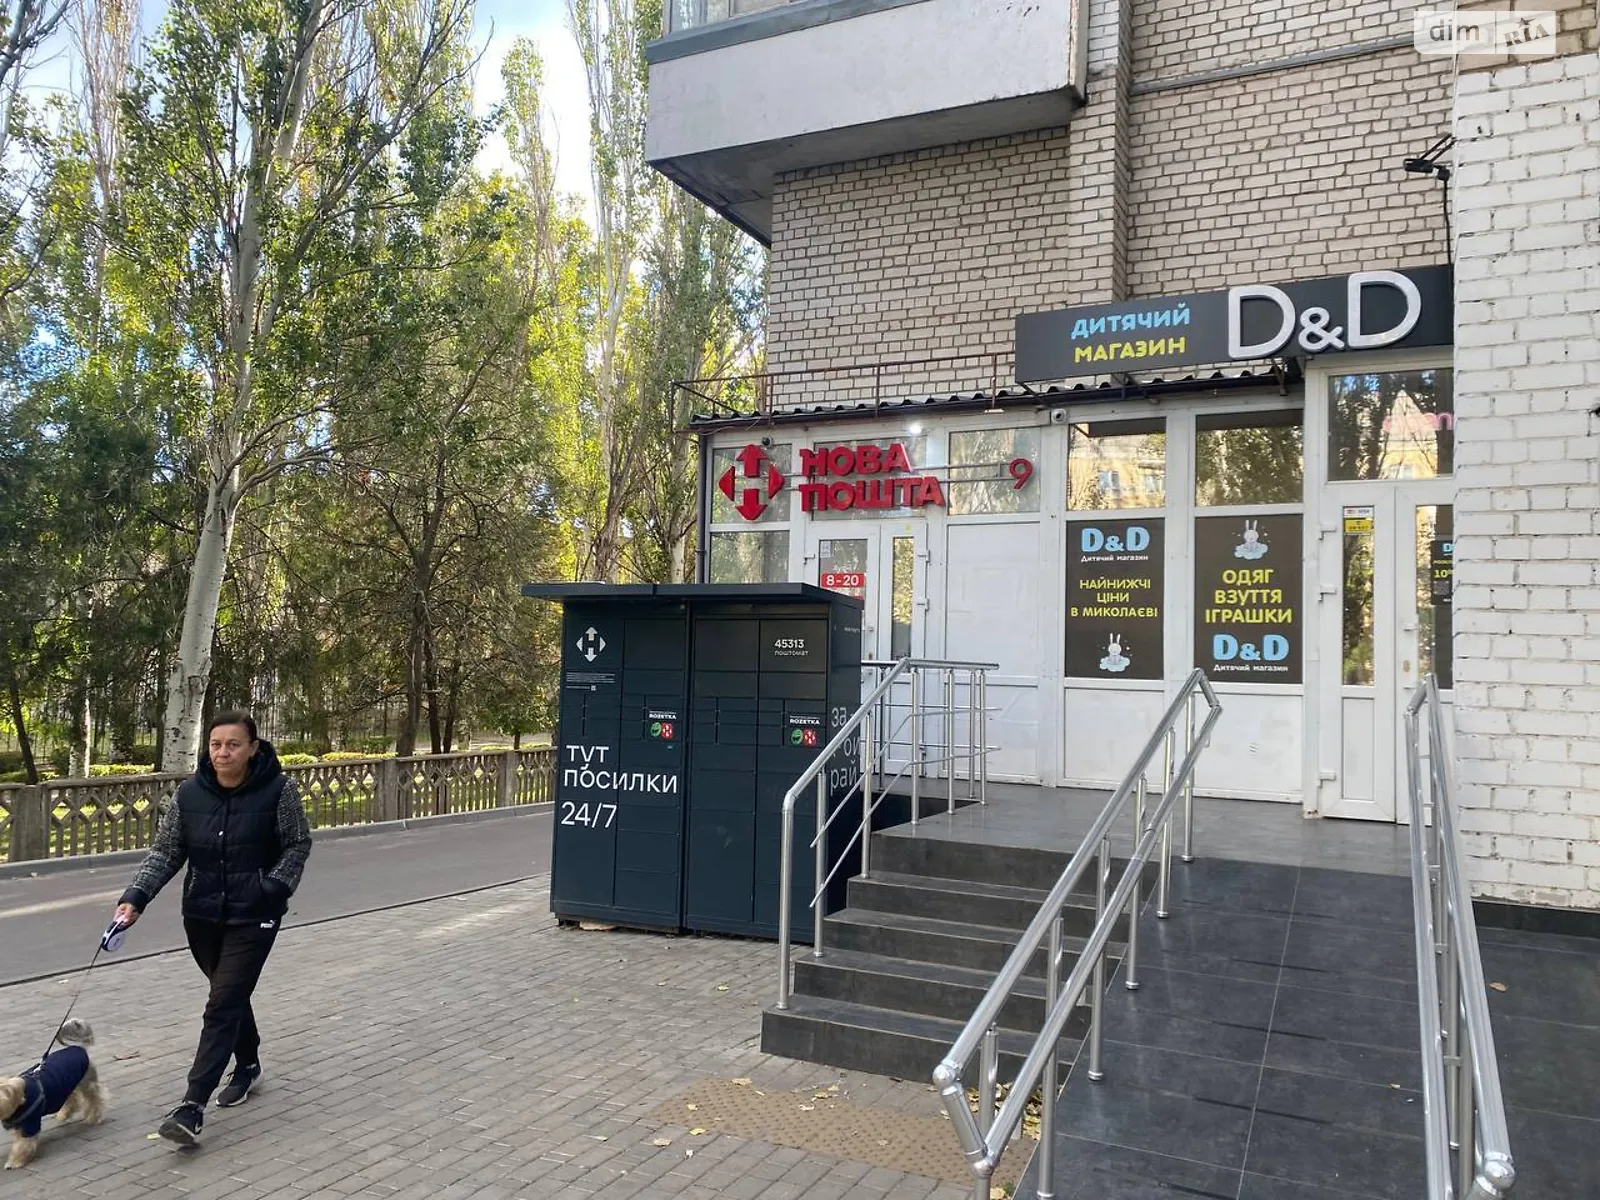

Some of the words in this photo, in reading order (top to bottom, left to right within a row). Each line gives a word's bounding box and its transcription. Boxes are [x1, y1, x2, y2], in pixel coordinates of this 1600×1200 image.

[1070, 303, 1190, 340] ДИТЯЧИЙ
[1228, 270, 1421, 360] D&D
[1074, 337, 1186, 363] МАГАЗИН
[799, 443, 913, 477] НОВА
[1009, 458, 1033, 490] 9
[799, 476, 946, 511] ПОШТА
[1081, 526, 1150, 552] D&D
[1079, 576, 1151, 590] НАЙНИЖЧІ
[1222, 569, 1274, 586] ОДЯГ
[1096, 592, 1130, 604] ЦІНИ
[1214, 589, 1282, 606] ВЗУТТЯ
[1070, 607, 1079, 617] В
[1082, 606, 1158, 618] МИКОЛАЄВІ
[1205, 608, 1293, 624] ІГРАШКИ
[774, 638, 805, 649] 45313
[1213, 633, 1290, 661] D&D
[560, 801, 618, 829] 24/7
